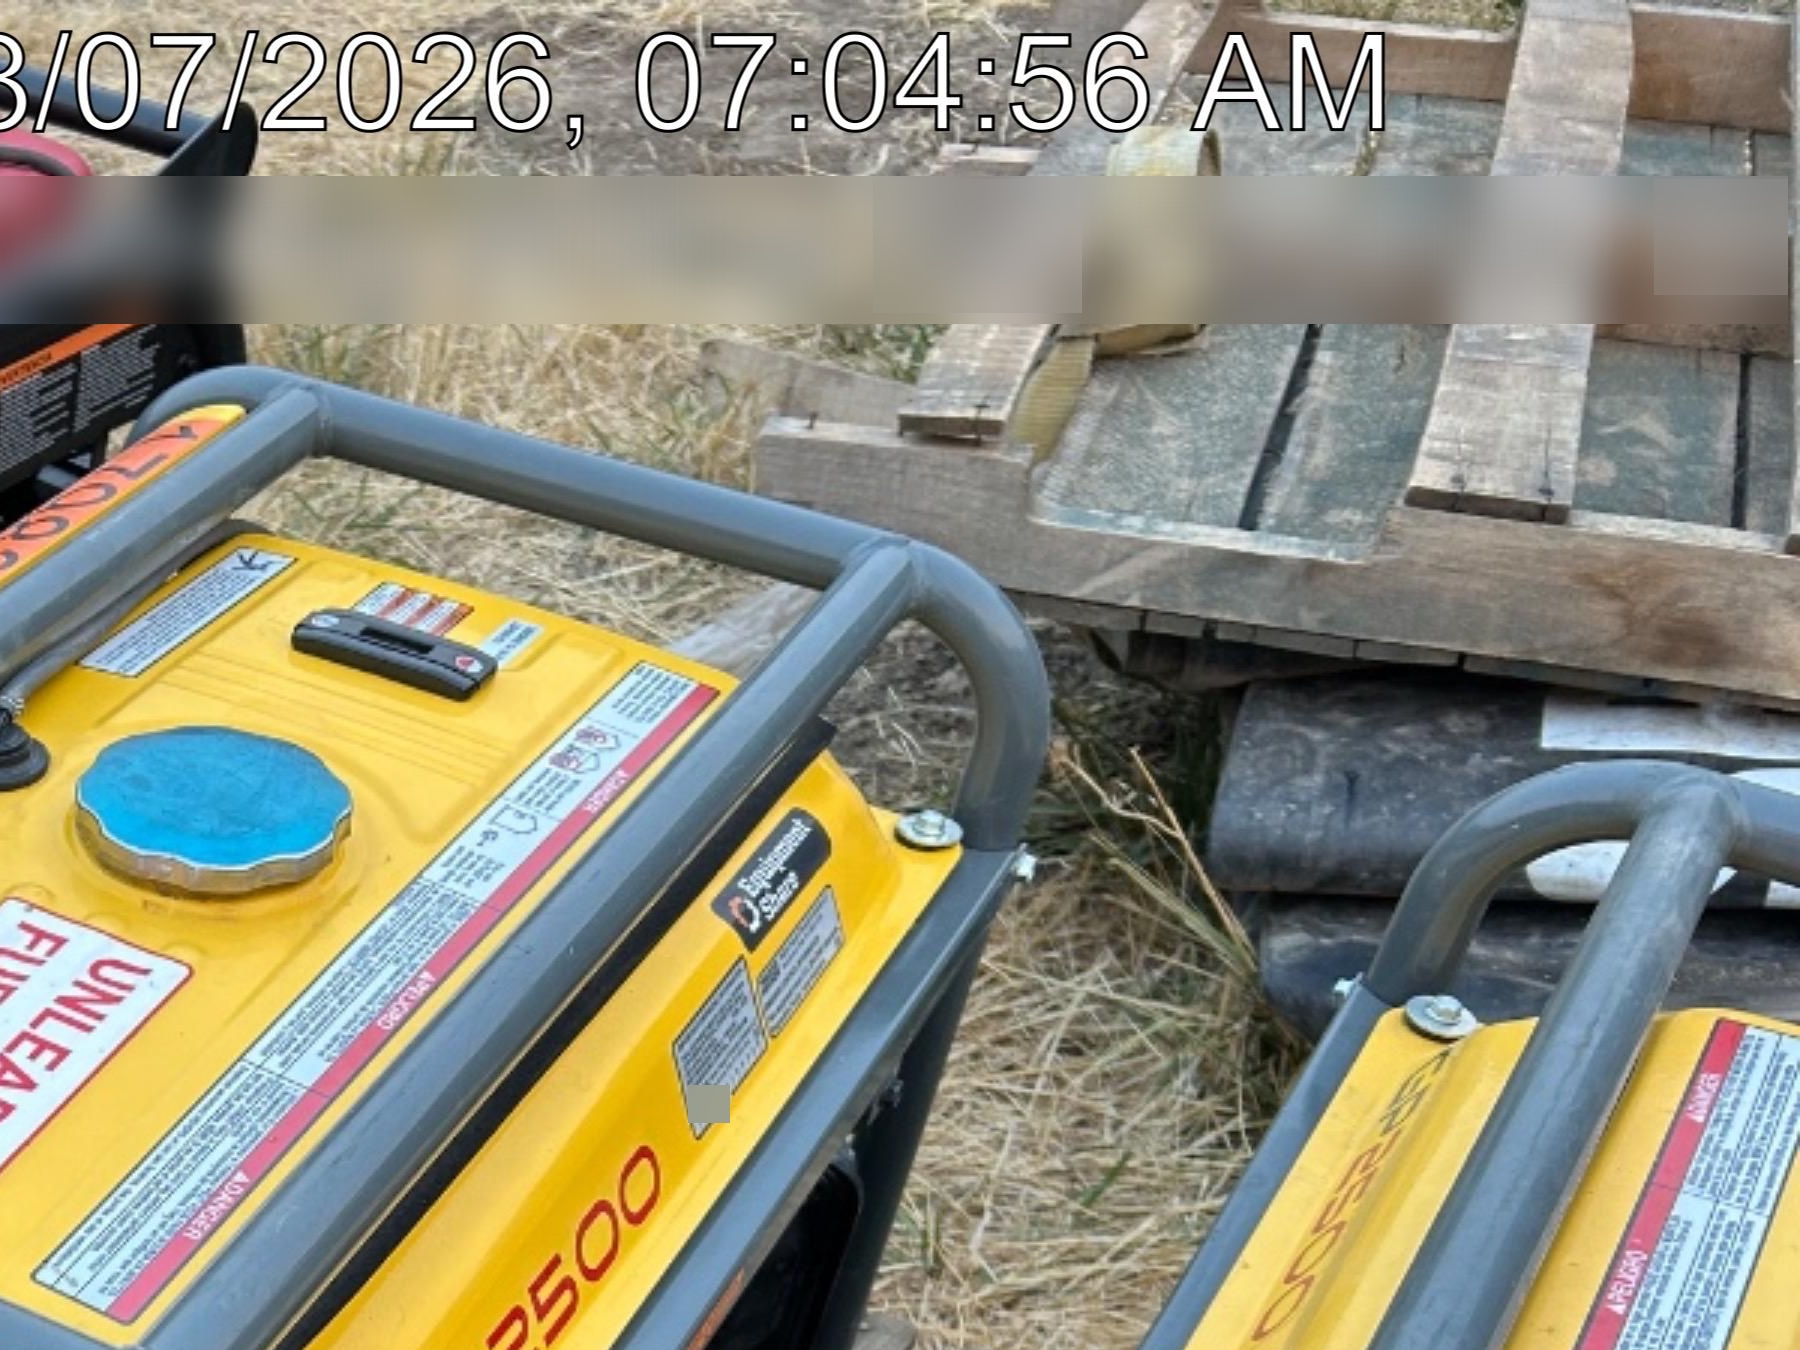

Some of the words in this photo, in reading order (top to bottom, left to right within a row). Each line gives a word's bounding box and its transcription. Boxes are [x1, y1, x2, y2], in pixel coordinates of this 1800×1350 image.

[737, 817, 813, 897] Equipment
[759, 871, 800, 921] Share
[183, 1179, 240, 1242] DANGER
